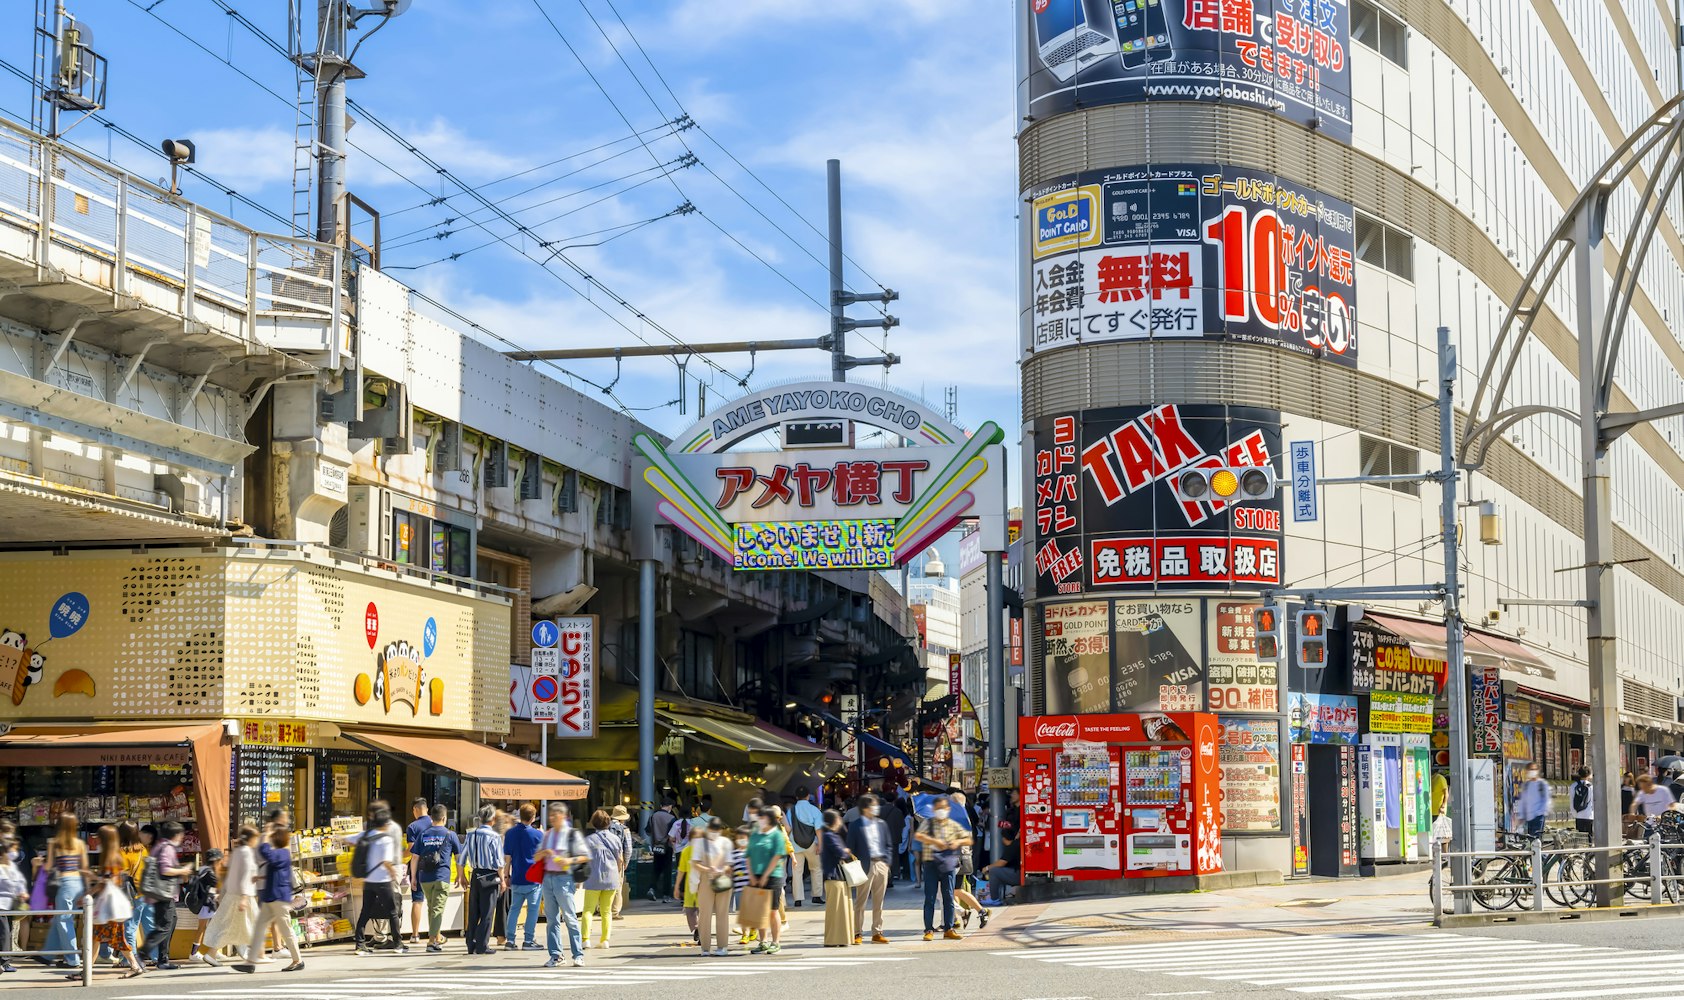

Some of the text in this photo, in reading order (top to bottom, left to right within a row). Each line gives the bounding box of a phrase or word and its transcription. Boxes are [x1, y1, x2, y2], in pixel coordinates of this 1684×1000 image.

[1143, 83, 1286, 113] www.yodobashi.com
[1103, 170, 1193, 182] ゴールドポイントカードプラス
[1047, 203, 1079, 224] GOLD
[1152, 212, 1170, 220] 2345
[1040, 223, 1062, 241] POINT
[1063, 219, 1088, 233] CARD
[1176, 228, 1198, 237] VISA
[1281, 225, 1354, 288] ポイント還元
[1036, 259, 1086, 293] 入会金
[1097, 251, 1194, 304] 無料
[1036, 284, 1086, 318] 年会費
[1035, 306, 1199, 348] 店頭にてすぐ発行
[712, 389, 922, 440] AMEYAYOKOCHO
[1082, 404, 1207, 508] TAX
[458, 468, 470, 484] 266
[714, 459, 930, 510] アメヤ横丁
[1053, 415, 1077, 533] ヨドバシ
[1295, 446, 1313, 518] 歩車分離式
[1036, 449, 1053, 536] カメラ
[1234, 506, 1281, 532] STORE
[801, 550, 829, 567] We
[830, 548, 863, 567] will
[865, 547, 887, 566] be
[1035, 537, 1062, 578] TAX
[1050, 546, 1084, 586] FREE
[1096, 545, 1278, 579] 免税品取扱店
[1057, 580, 1082, 595] STORE
[1045, 602, 1194, 619] ヨドバシカメラ でお買い物なら
[559, 621, 592, 630] レストラン
[1063, 621, 1083, 630] GOLD
[1084, 620, 1108, 629] POINT
[1352, 630, 1375, 649] スマホ
[1120, 650, 1175, 676] 2345 6789
[1352, 648, 1375, 668] ゲーム
[1163, 666, 1199, 685] VISA
[1352, 668, 1375, 688] おもちゃ
[1374, 669, 1435, 695] ヨドバシカメラ
[1036, 722, 1078, 737] Coca-Cola
[163, 753, 185, 761] CAFE
